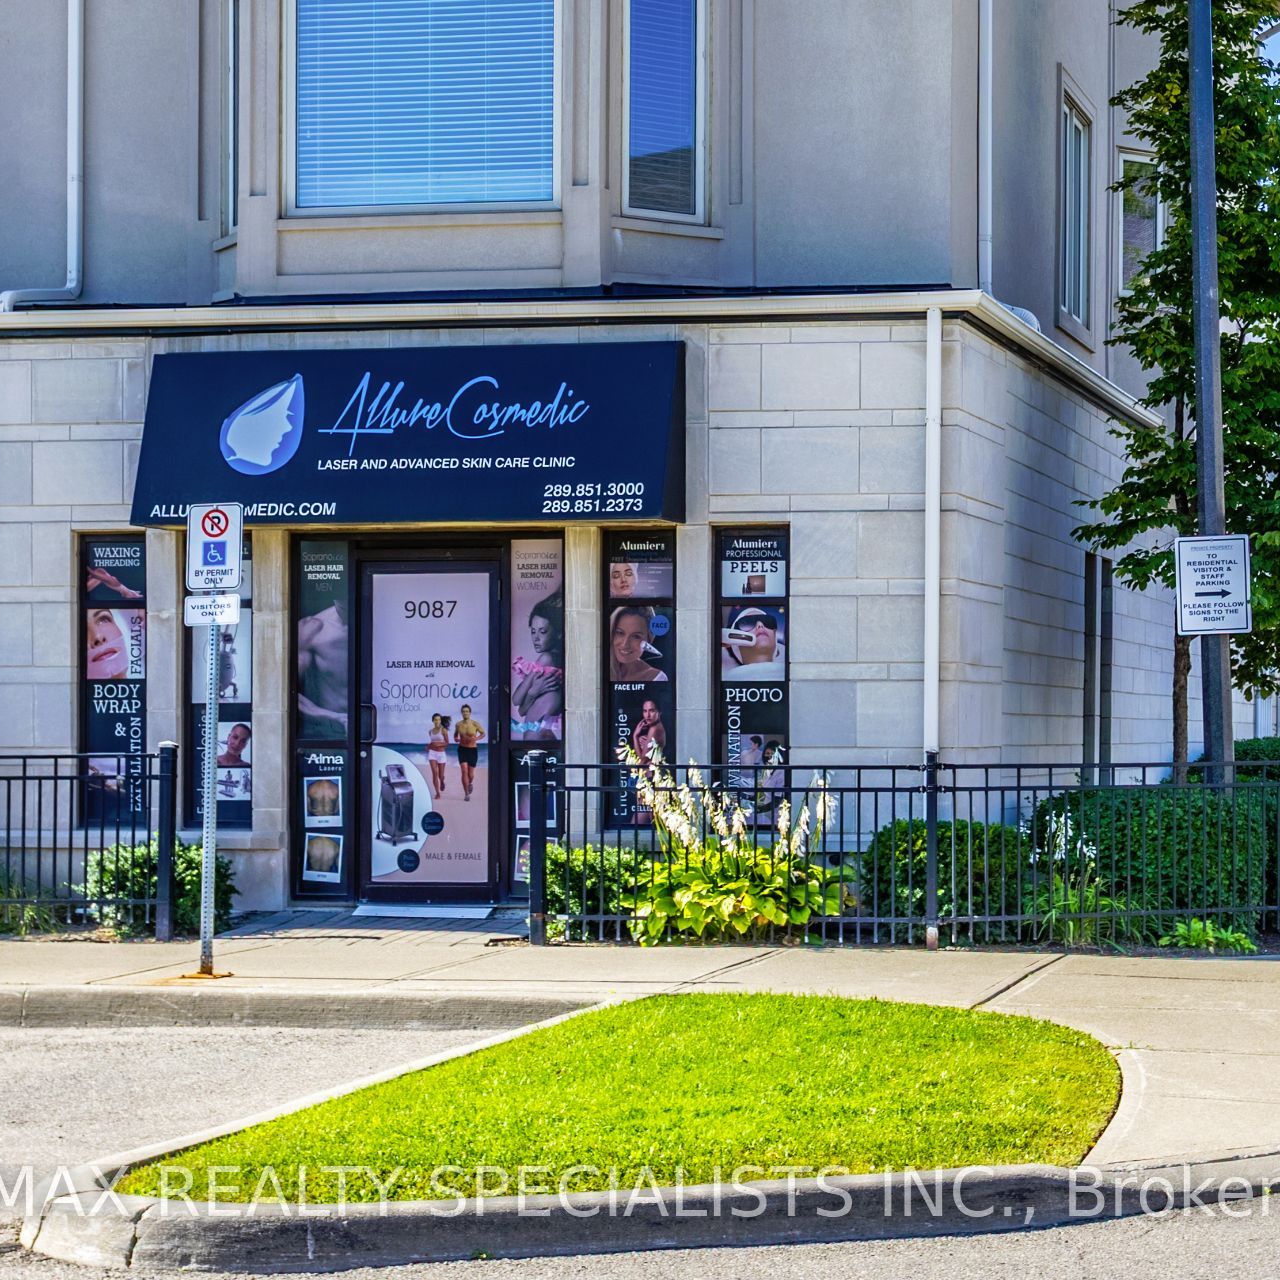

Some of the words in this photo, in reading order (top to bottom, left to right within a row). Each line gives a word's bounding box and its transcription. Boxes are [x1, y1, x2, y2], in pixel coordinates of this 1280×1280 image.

[317, 459, 358, 471] LASER
[360, 459, 388, 470] AND
[390, 458, 459, 470] ADVANCED
[462, 458, 492, 469] SKIN
[495, 457, 530, 468] CARE
[532, 456, 576, 468] CLINIC
[543, 482, 645, 497] 289.851.3000
[150, 502, 337, 518] ALLUMEDIC.COM
[542, 498, 643, 513] 289.851.2373
[93, 547, 141, 558] WAXING
[725, 549, 783, 558] PROFESSIONAL
[93, 559, 140, 567] THREADING
[304, 564, 326, 572] LASER
[730, 561, 779, 573] PEELS
[194, 569, 205, 577] BY
[206, 568, 234, 577] PERMIT
[520, 571, 554, 579] REMOVAL
[204, 577, 224, 585] ONLY
[404, 600, 458, 619] 9087
[130, 616, 142, 675] FACIALS
[386, 660, 412, 669] LASER
[413, 660, 434, 668] HAIR
[435, 660, 475, 668] REMOVAL
[93, 684, 141, 698] BODY
[614, 683, 631, 691] FACE
[632, 683, 645, 691] LIFT
[725, 688, 783, 702] PHOTO
[93, 700, 141, 714] WRAP
[114, 722, 127, 737] &
[304, 753, 344, 765] Alma
[517, 754, 557, 766] Aa
[425, 852, 445, 861] MALE
[447, 852, 452, 860] &
[454, 852, 482, 860] FEMALE
